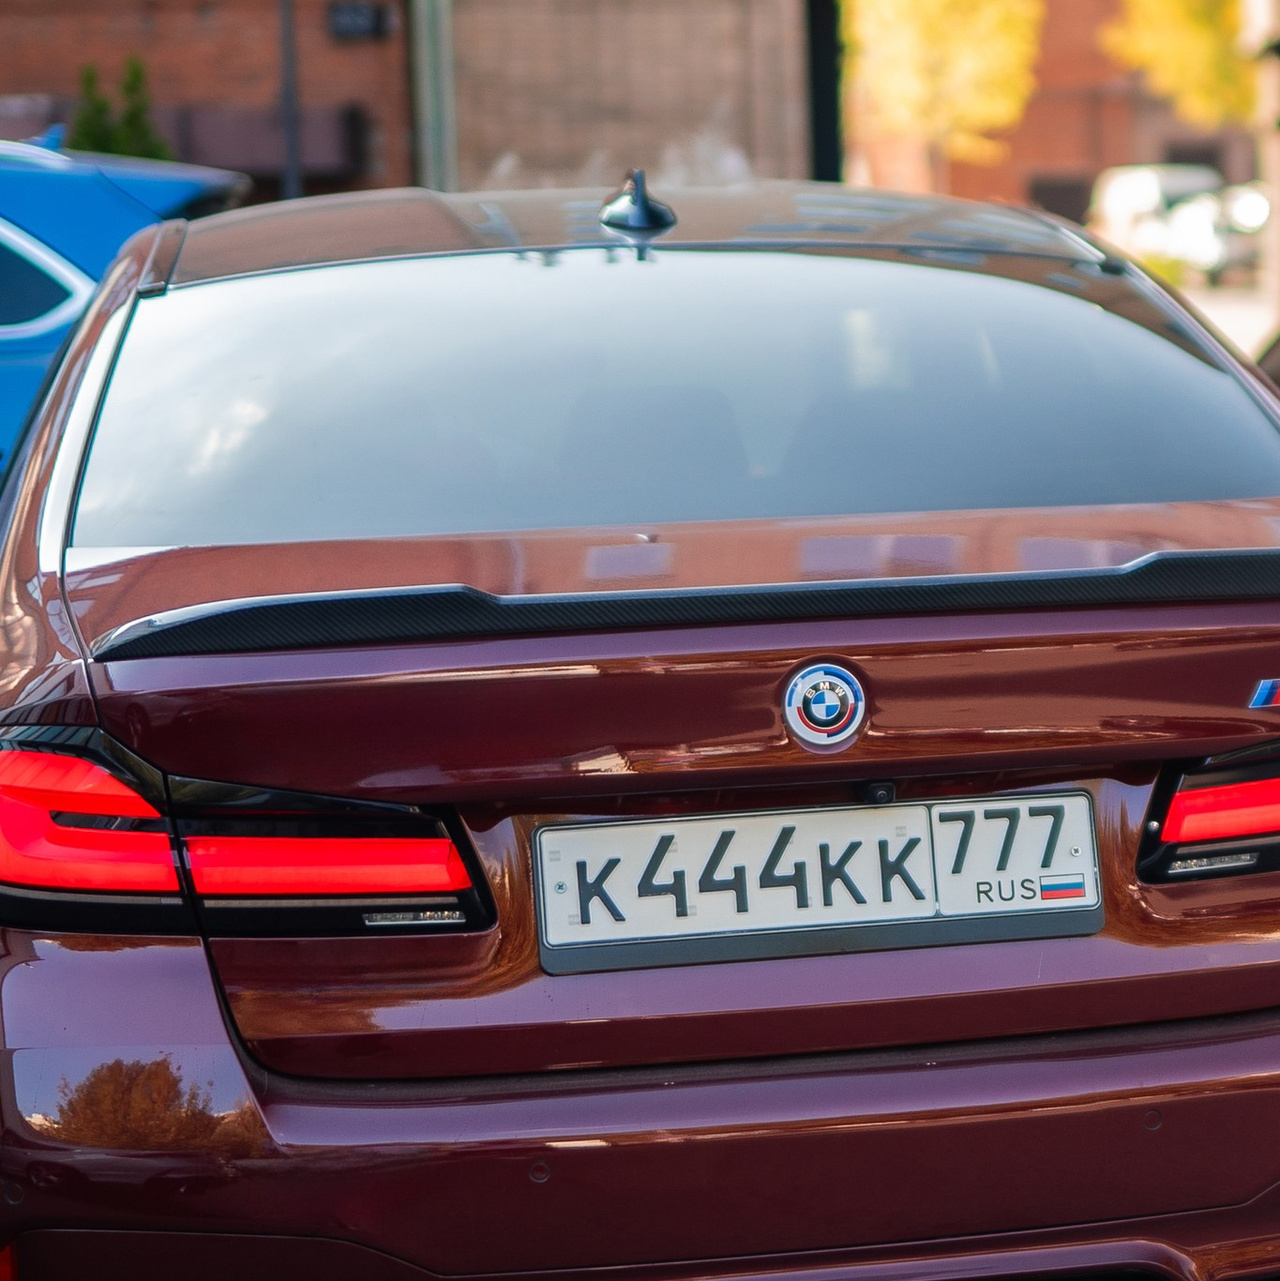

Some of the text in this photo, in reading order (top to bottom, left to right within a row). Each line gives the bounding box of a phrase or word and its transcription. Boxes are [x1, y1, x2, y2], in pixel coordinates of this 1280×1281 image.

[805, 681, 846, 699] BMW
[576, 804, 1066, 925] K444KK 777
[976, 876, 1037, 904] RUS
